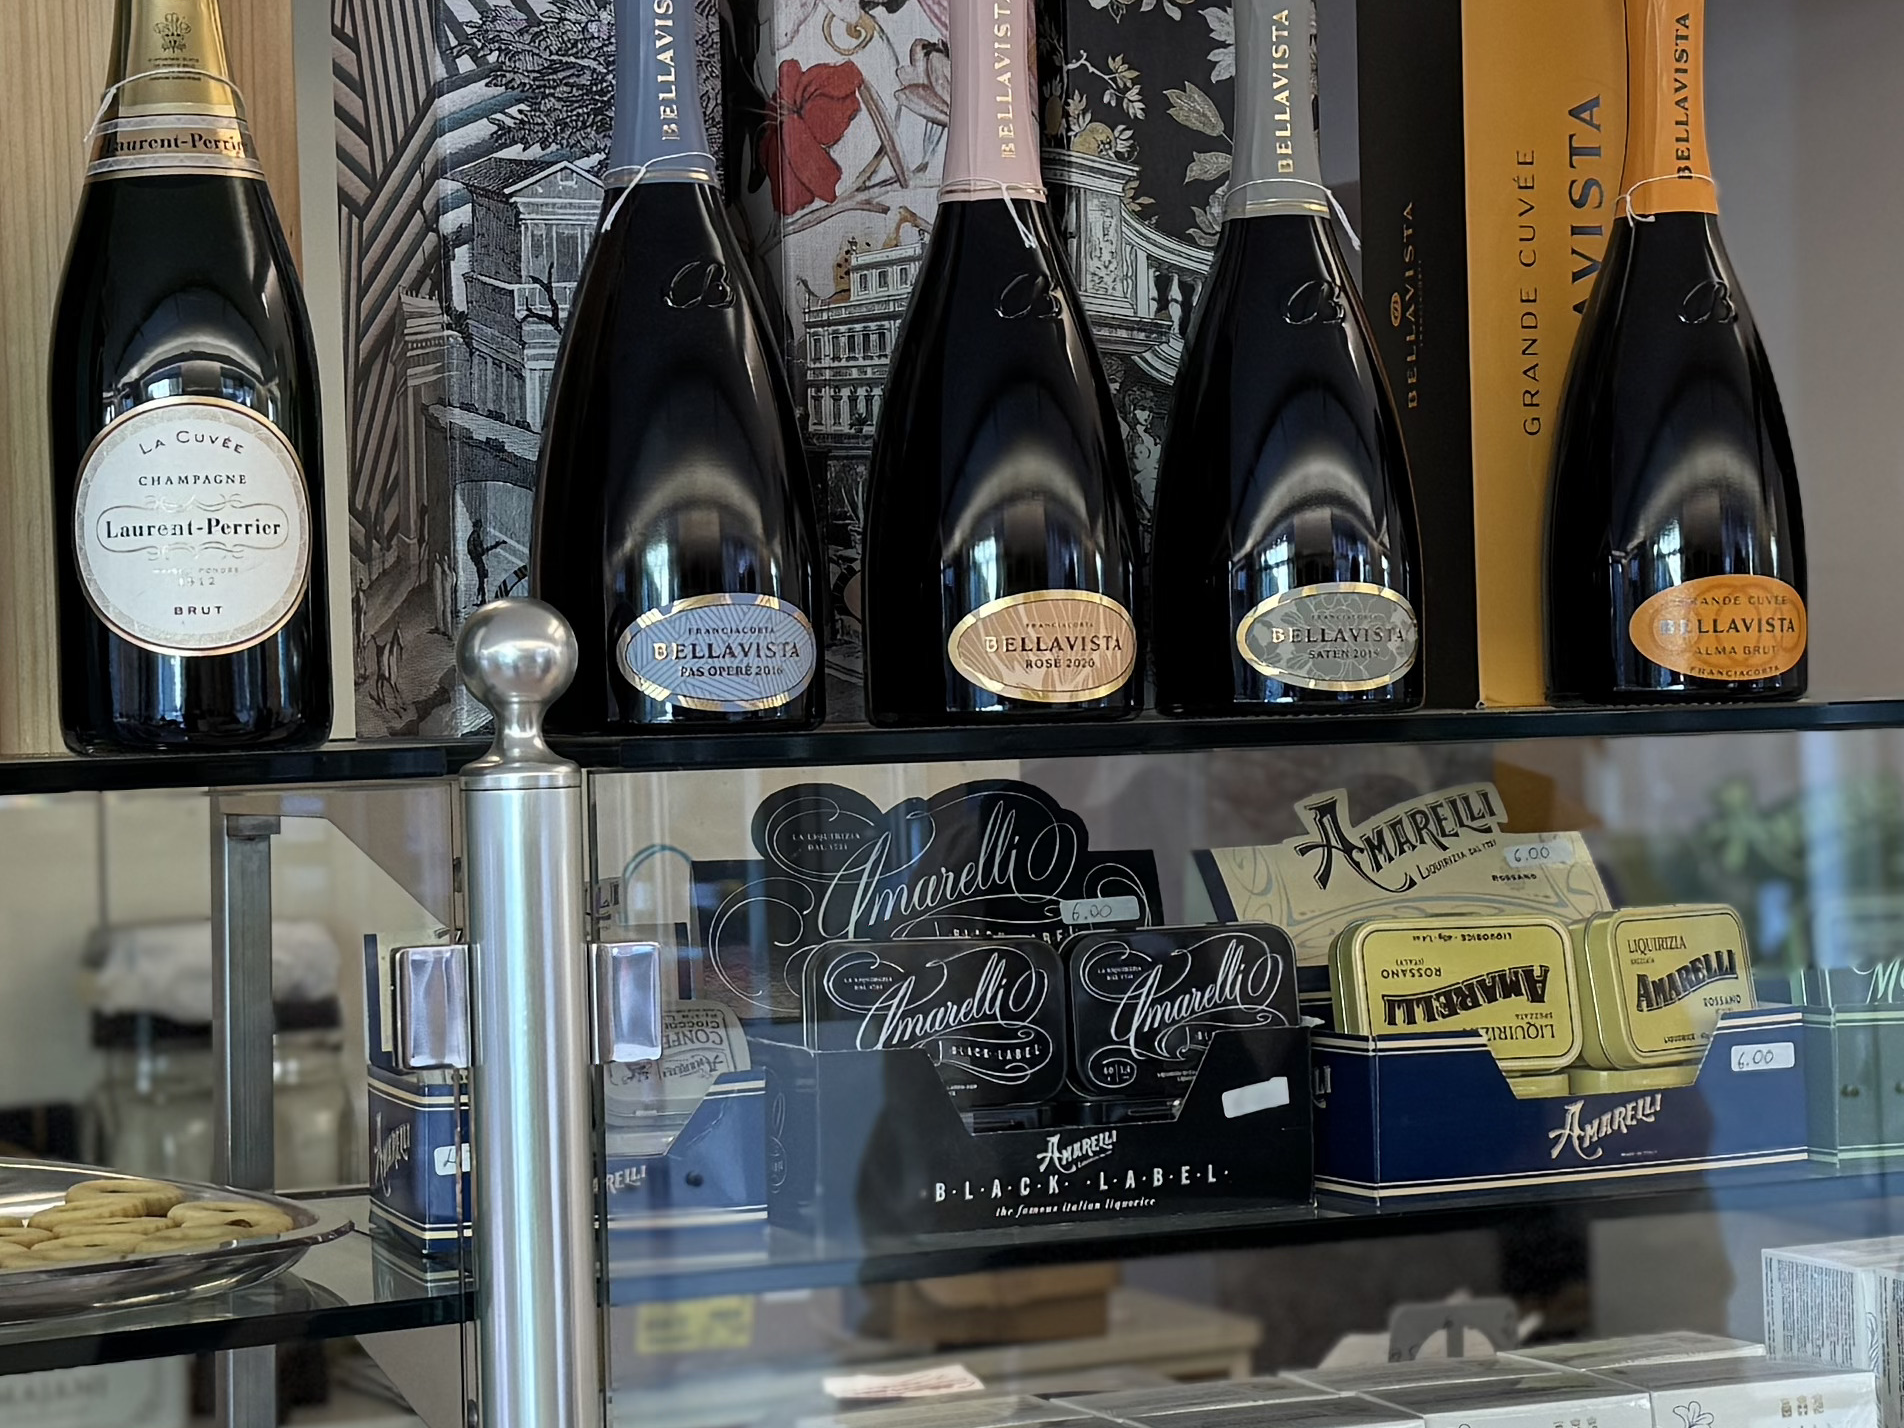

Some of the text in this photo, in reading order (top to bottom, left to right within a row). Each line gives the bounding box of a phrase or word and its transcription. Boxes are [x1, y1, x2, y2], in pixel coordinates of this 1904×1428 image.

[1272, 9, 1294, 174] BELLAVISTA
[1673, 13, 1693, 180] BELLAVISTA
[1512, 149, 1542, 437] GRANDE CUVÉE
[1403, 201, 1418, 408] BELLAVISTA
[138, 474, 247, 486] CHAMPAGNE
[105, 517, 281, 540] Laurent-Perrier
[174, 605, 224, 616] BRUT
[985, 635, 1122, 653] BELLAVISTA
[1272, 627, 1404, 644] BELLAVISTA
[653, 641, 800, 660] BELLAVISTA
[680, 666, 705, 677] PAS
[1026, 655, 1062, 669] ROSÉ
[1513, 846, 1550, 863] 6.00
[818, 801, 1019, 939] Amarelli
[1627, 934, 1687, 954] LIQUIRIZIA
[1381, 966, 1442, 980] ROSSANO
[856, 952, 1007, 1050] Amarelli
[1111, 939, 1245, 1050] Amarelli
[1737, 1049, 1775, 1070] 6.00
